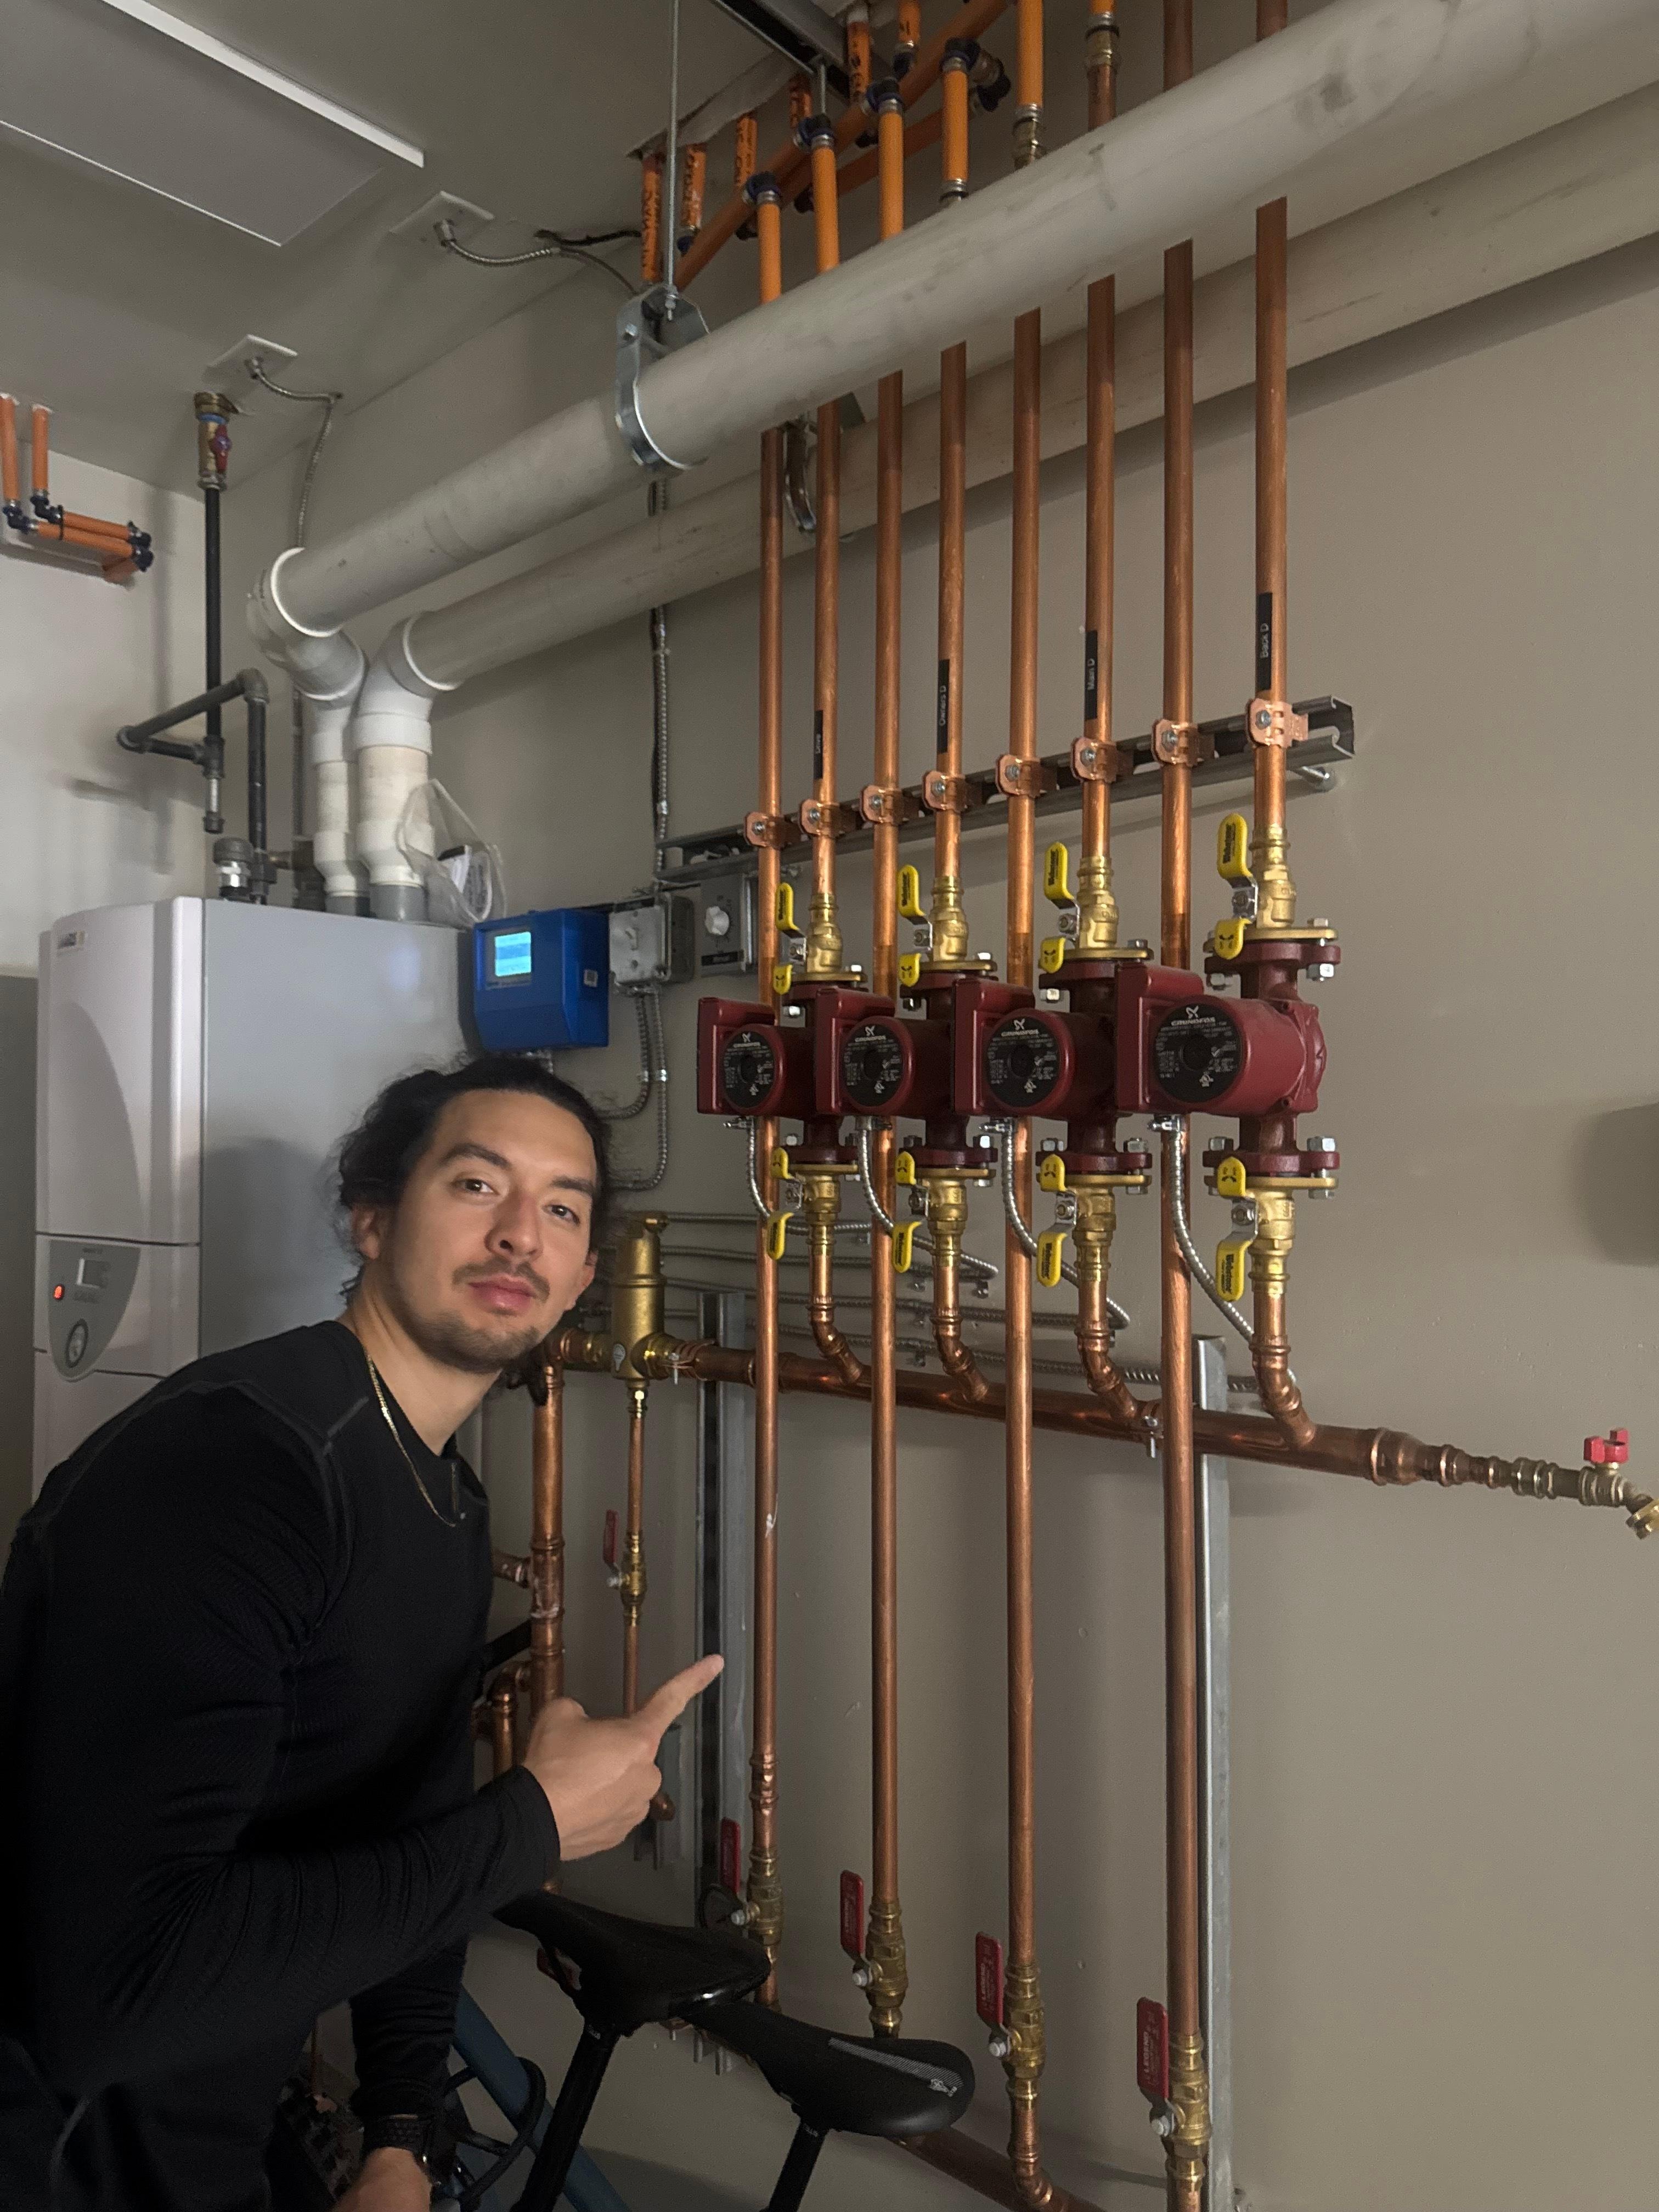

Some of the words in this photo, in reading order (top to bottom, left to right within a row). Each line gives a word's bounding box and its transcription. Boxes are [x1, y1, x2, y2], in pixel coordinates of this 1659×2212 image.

[1260, 623, 1269, 632] D
[1087, 658, 1096, 667] D
[939, 685, 946, 693] D
